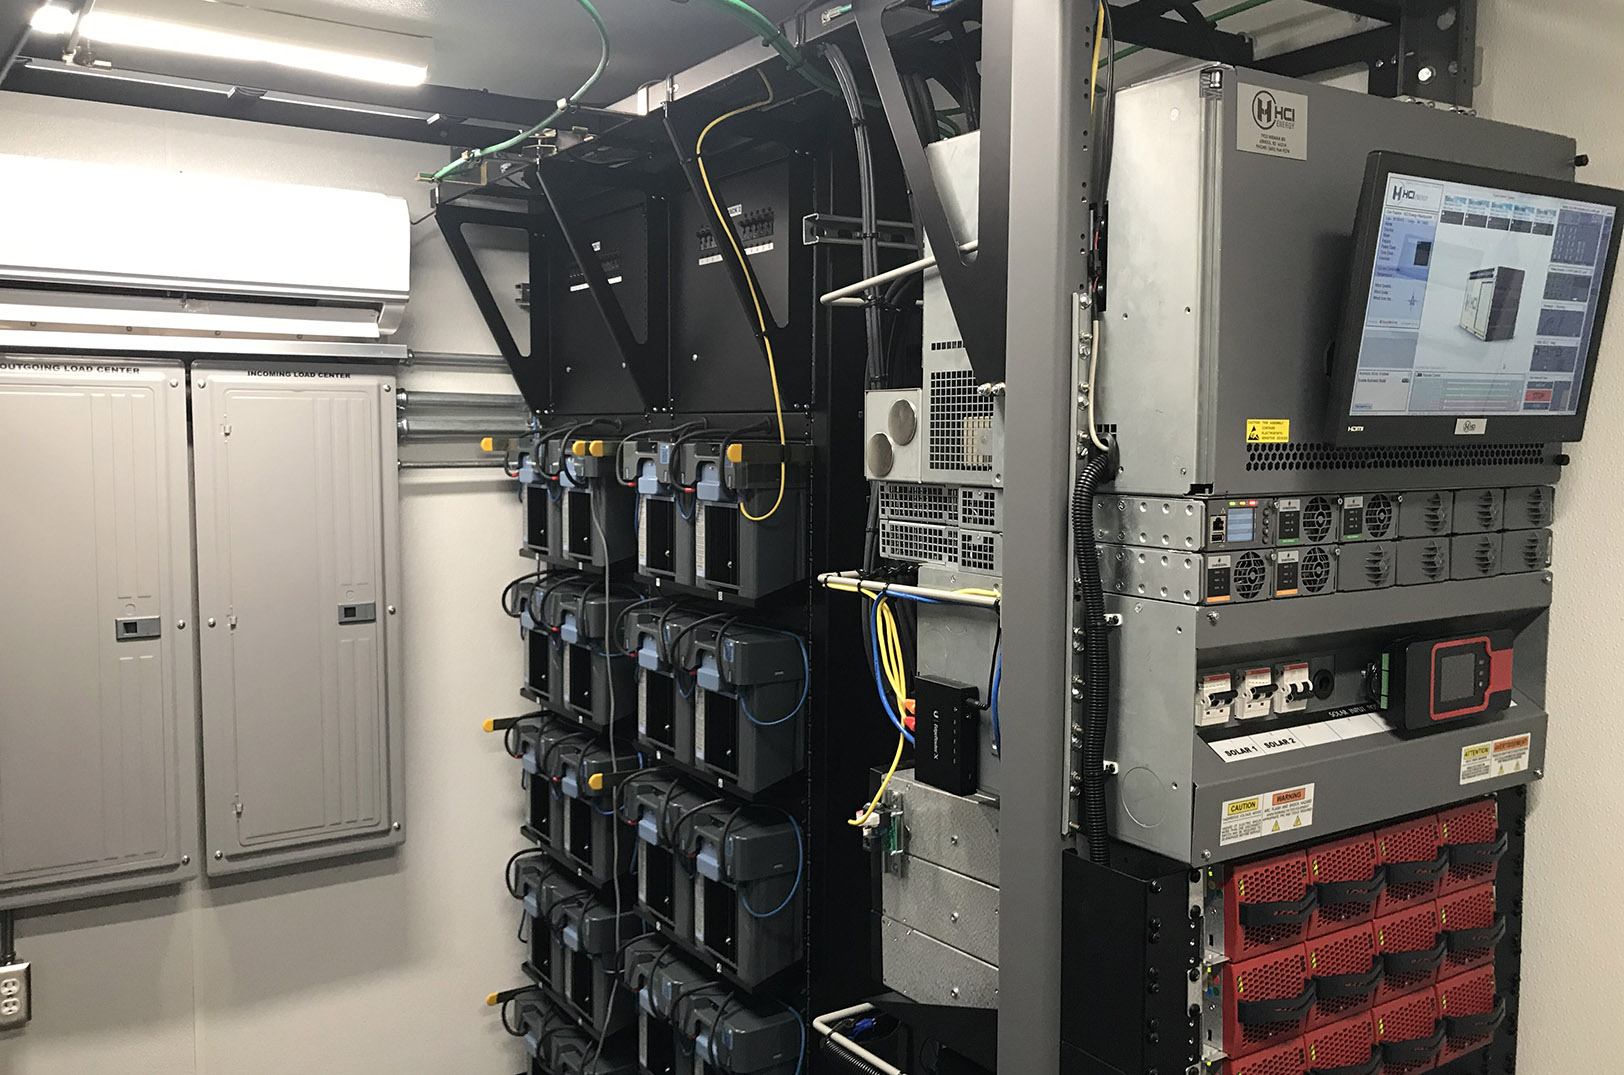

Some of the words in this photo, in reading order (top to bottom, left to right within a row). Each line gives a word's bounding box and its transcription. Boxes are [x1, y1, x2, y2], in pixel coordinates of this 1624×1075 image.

[1274, 106, 1295, 122] HCI
[1276, 120, 1295, 130] ENERGY
[0, 362, 60, 371] OUTGOING
[64, 365, 93, 373] LOAD
[96, 366, 140, 374] CENTER
[247, 370, 292, 378] INCOMING
[1328, 709, 1349, 718] SOLAR
[1264, 739, 1290, 749] SOLAR
[1224, 746, 1252, 757] SOLAR
[1464, 747, 1489, 757] ATTENTION
[1276, 791, 1302, 803] WARNING
[1230, 801, 1256, 812] CAUTION
